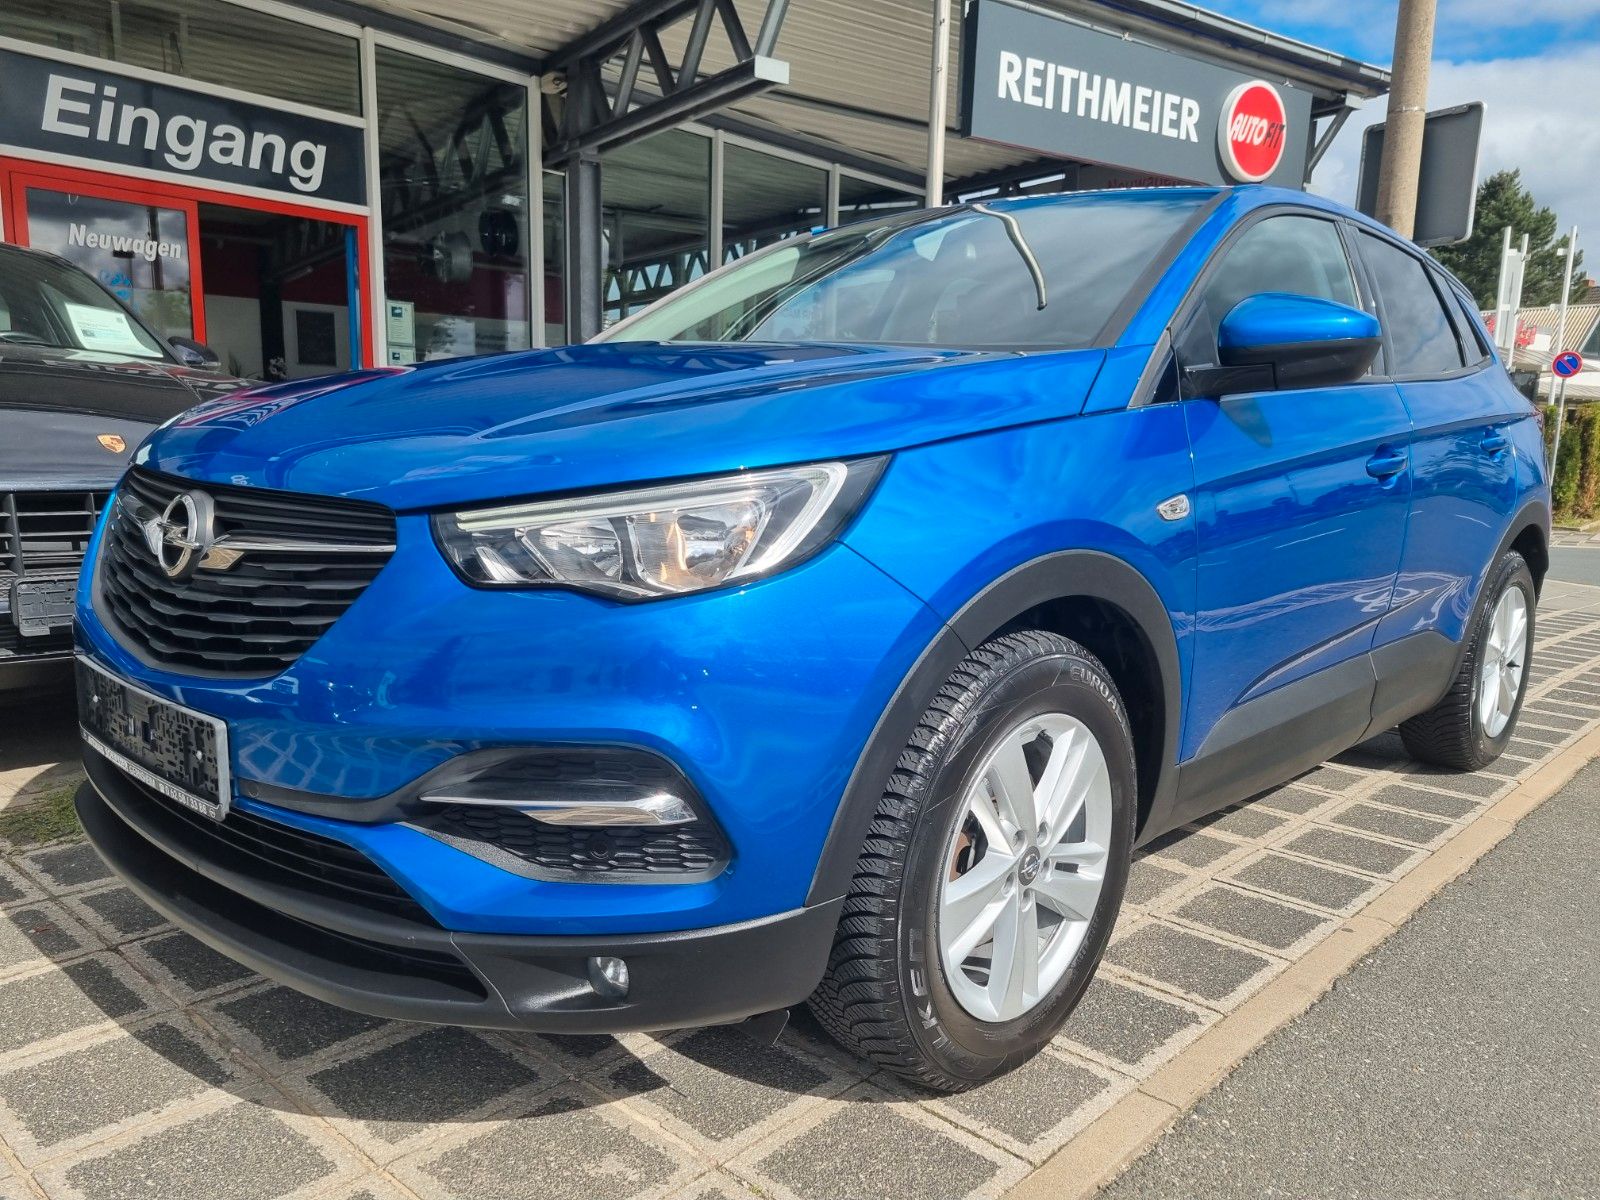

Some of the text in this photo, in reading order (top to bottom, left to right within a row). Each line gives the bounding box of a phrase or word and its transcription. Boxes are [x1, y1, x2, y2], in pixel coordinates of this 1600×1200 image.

[41, 73, 327, 193] Eingang
[997, 50, 1200, 143] REITHMEIER
[68, 223, 182, 262] Neuwagen
